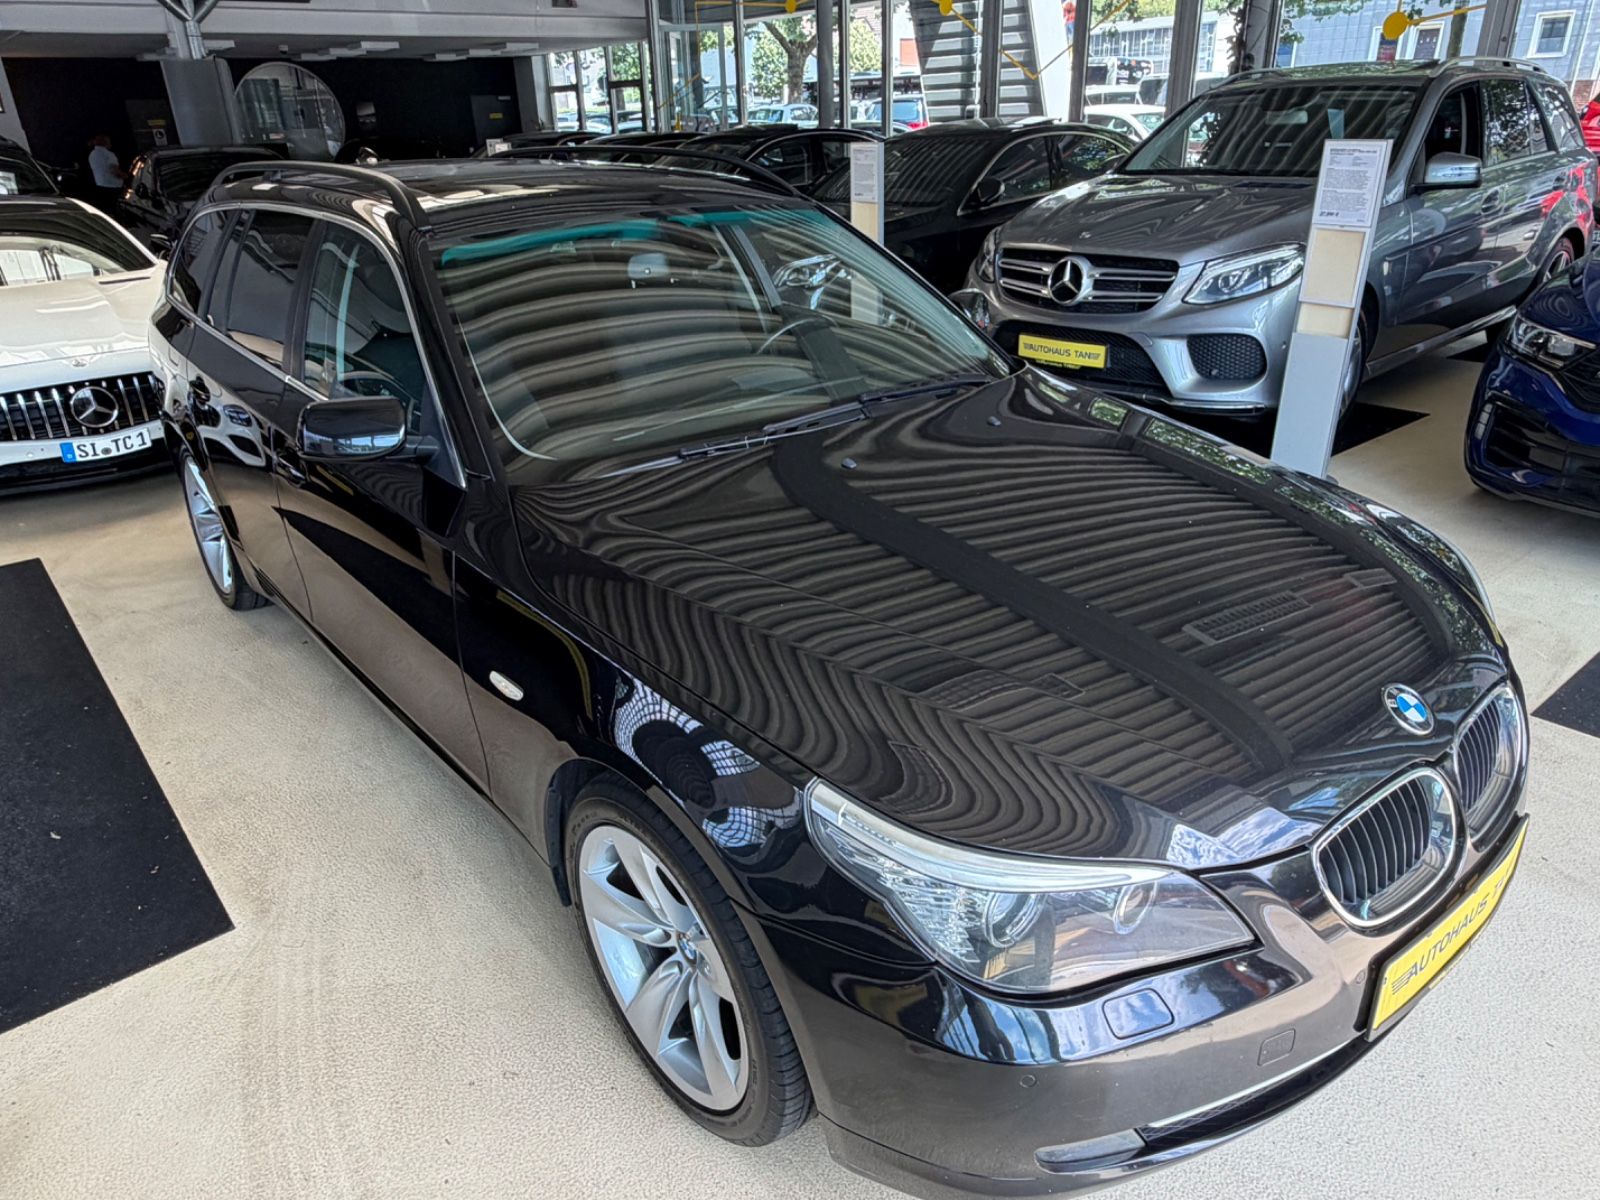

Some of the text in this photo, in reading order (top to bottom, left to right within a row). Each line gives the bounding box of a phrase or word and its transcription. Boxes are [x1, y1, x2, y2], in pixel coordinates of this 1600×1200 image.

[1029, 343, 1072, 358] AUTOHAUS
[76, 431, 147, 458] SI TC 1
[1405, 892, 1490, 978] AUTOHAUS
